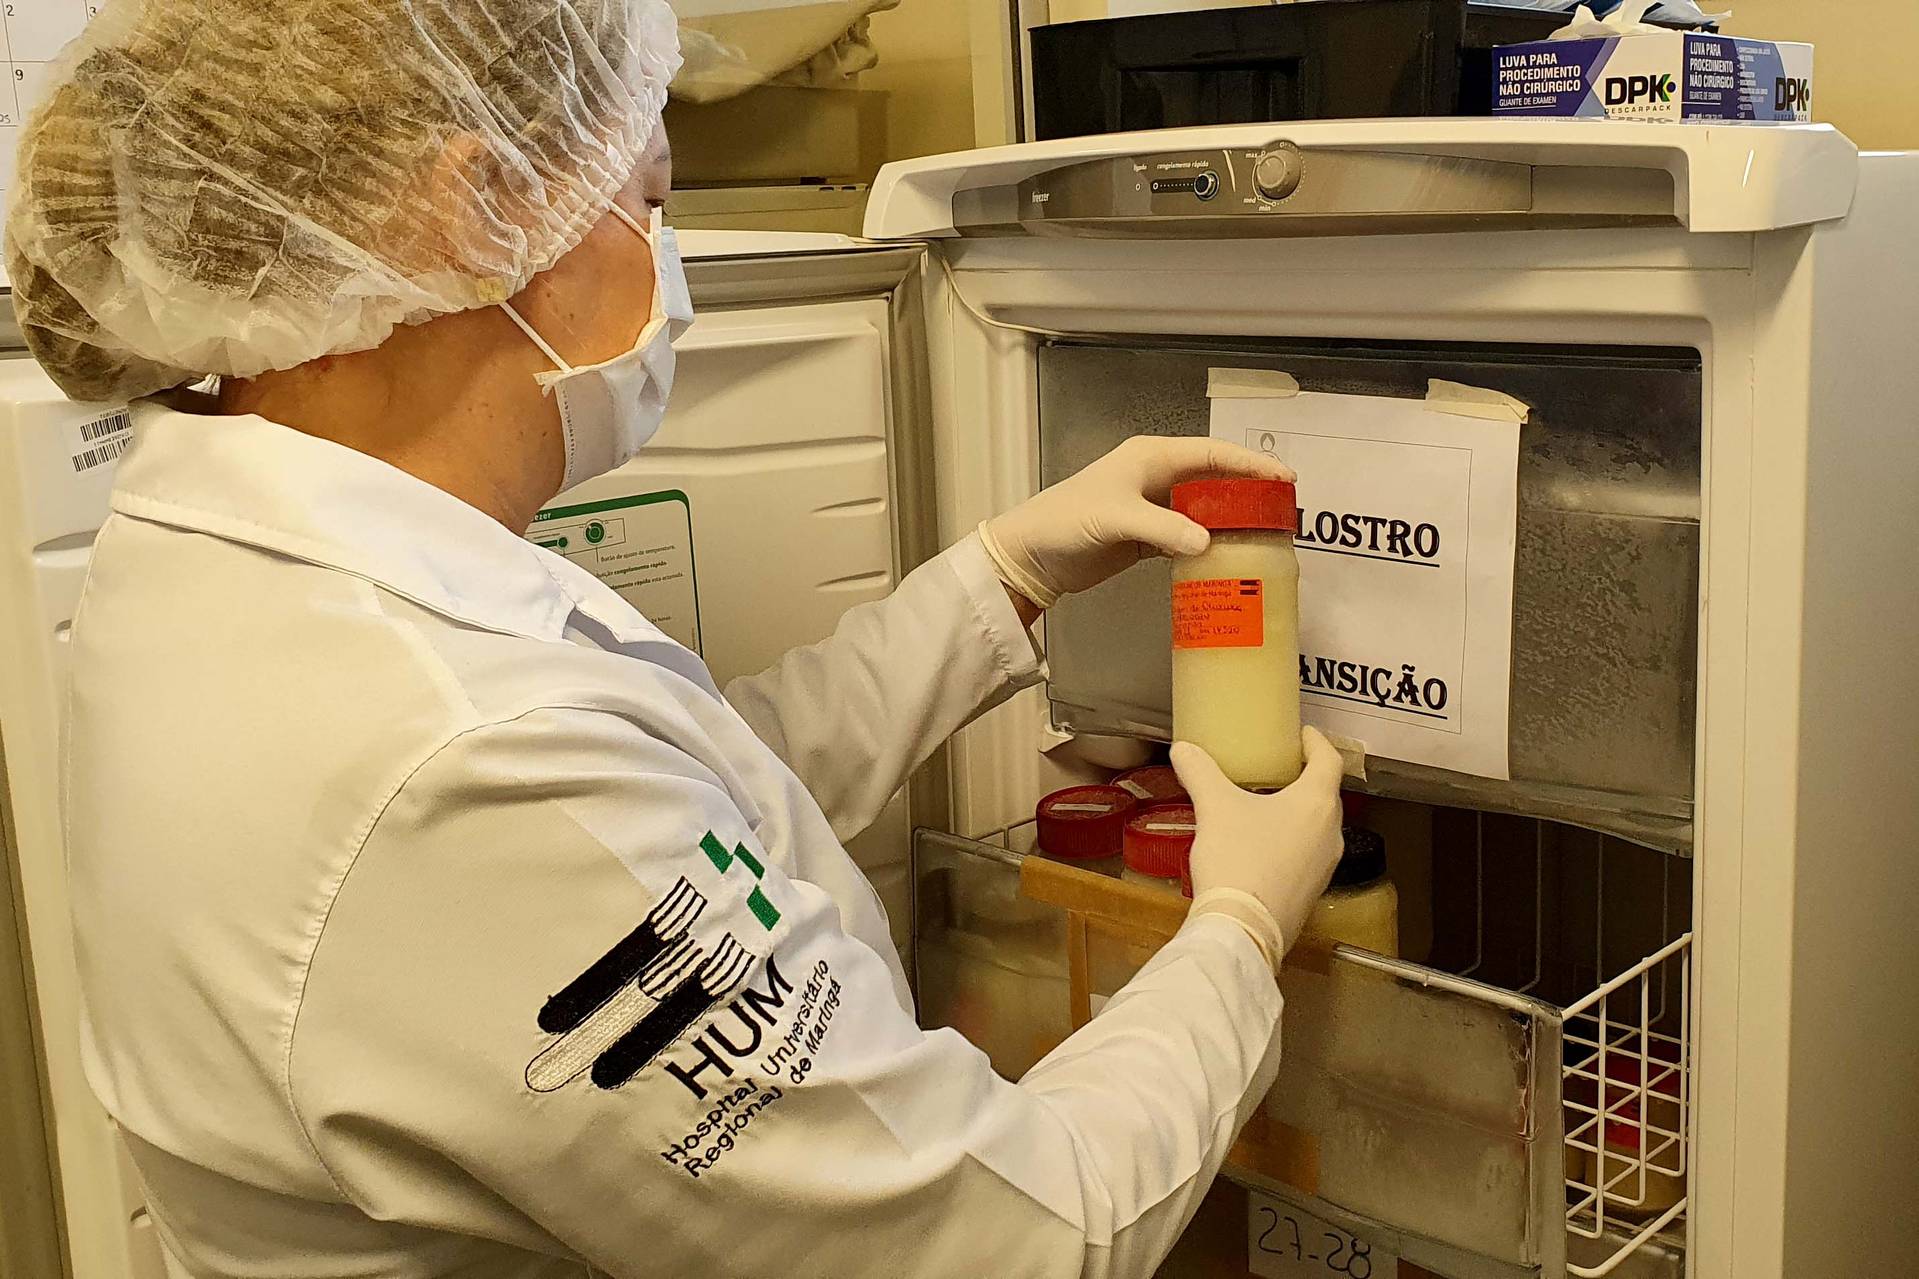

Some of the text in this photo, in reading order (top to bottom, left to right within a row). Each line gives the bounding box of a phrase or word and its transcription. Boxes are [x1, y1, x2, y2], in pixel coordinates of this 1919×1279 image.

[6, 5, 96, 17] 2 3
[1690, 42, 1721, 56] LUVA PARA
[1500, 53, 1557, 68] LUVA PARA
[1690, 58, 1734, 73] PROCEDIMENTO
[15, 70, 23, 80] 9
[1500, 66, 1580, 82] PROCEDIMENTO
[1690, 72, 1702, 87] NÃO
[1704, 73, 1734, 89] CIRÚRGICO
[1500, 79, 1580, 95] NÃO CIRÚRGICO
[1605, 74, 1672, 105] DPK
[1775, 78, 1807, 111] DPK
[1500, 96, 1556, 106] GUANTE DE EXAMEN
[1605, 105, 1671, 114] DESCARPACK
[664, 952, 794, 1100] HUM
[661, 959, 829, 1164] Hospital Universitário
[684, 976, 842, 1178] Regional de Maringá
[1258, 1208, 1372, 1279] 27-28
